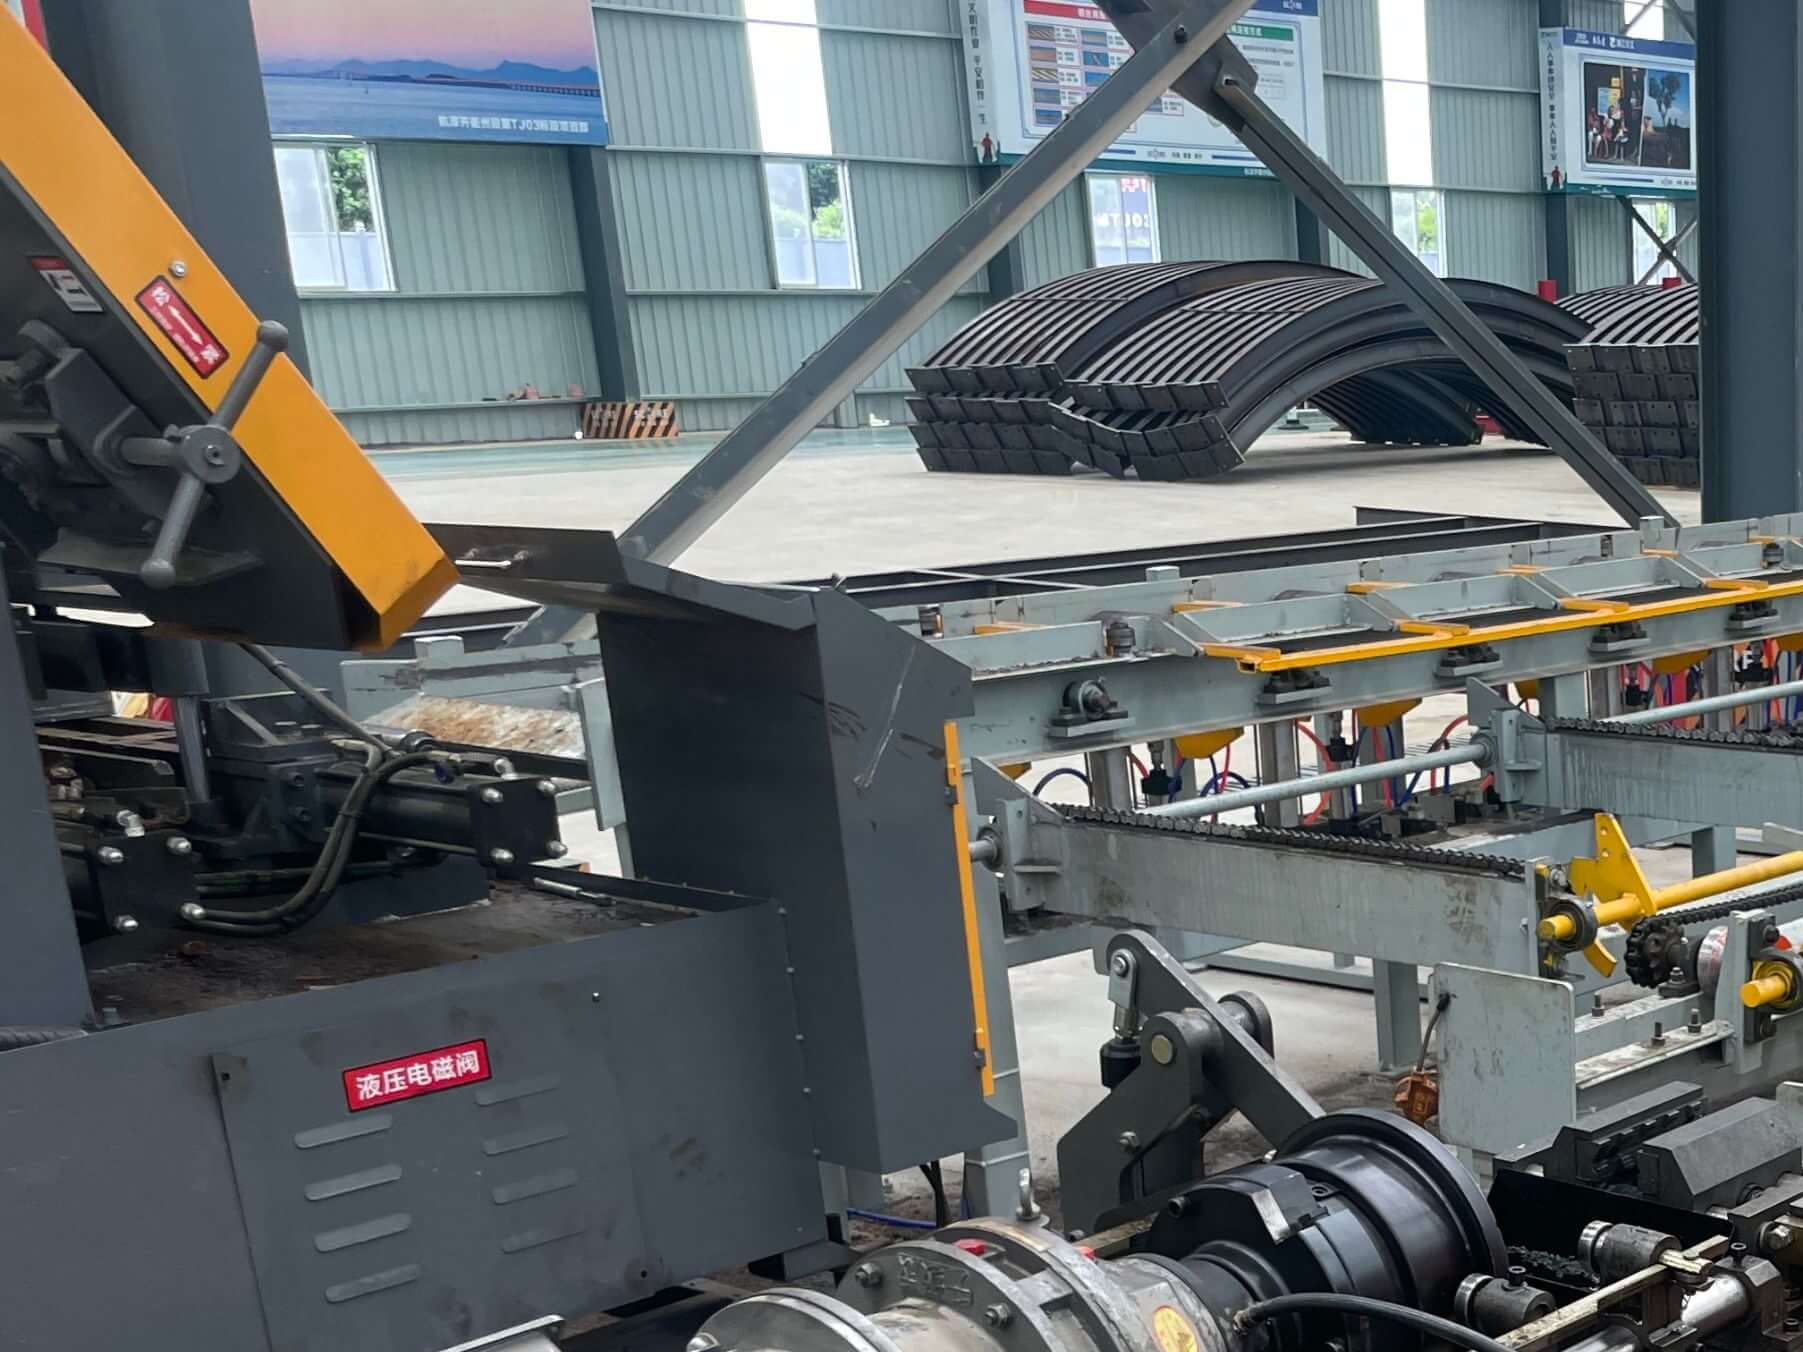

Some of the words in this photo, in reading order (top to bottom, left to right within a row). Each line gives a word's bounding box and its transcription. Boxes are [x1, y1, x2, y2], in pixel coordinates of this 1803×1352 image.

[356, 1050, 480, 1100] 液压电磁阀
